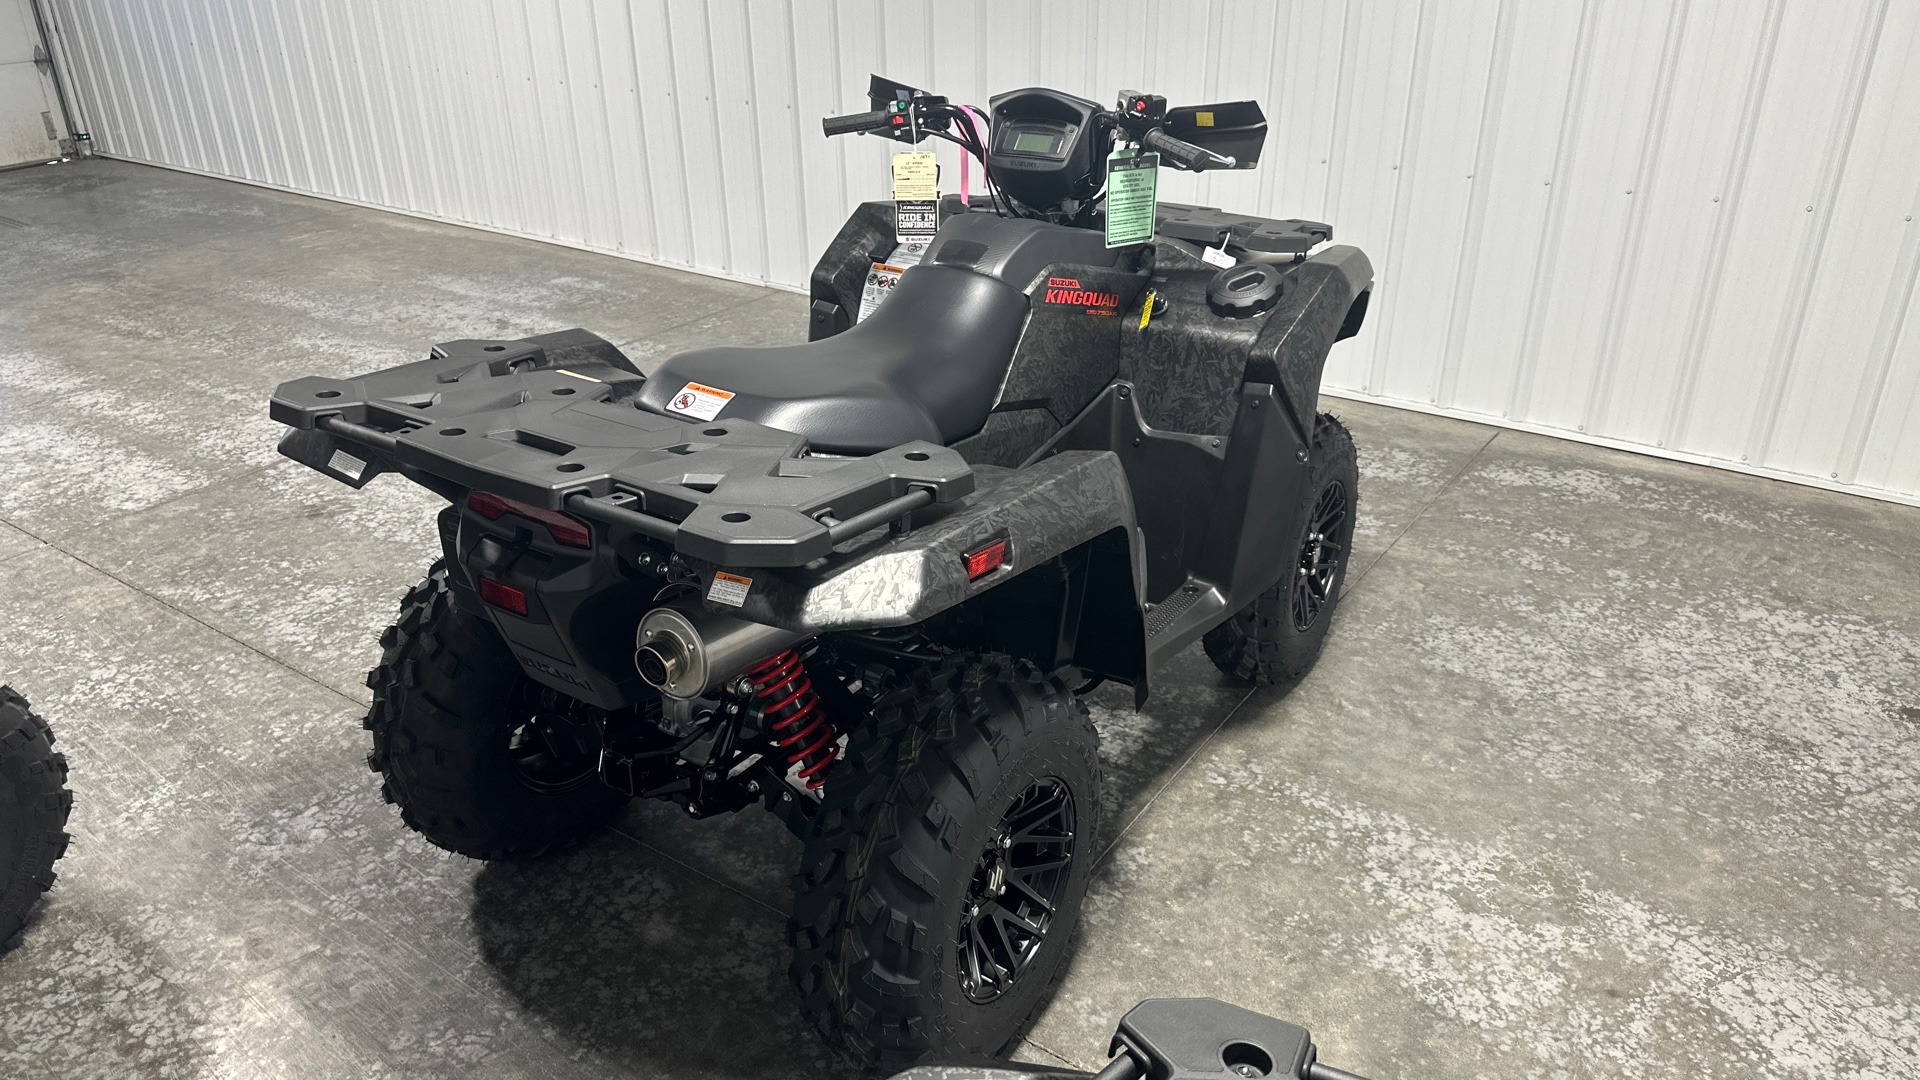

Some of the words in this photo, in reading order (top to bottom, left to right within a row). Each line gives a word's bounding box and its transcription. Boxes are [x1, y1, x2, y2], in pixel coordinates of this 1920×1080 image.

[898, 213, 922, 222] RIDE
[923, 213, 936, 222] IN
[898, 221, 936, 229] CONFIDENCE
[1050, 279, 1077, 287] SUZUKI
[1045, 289, 1120, 307] KINGQUAD
[515, 652, 595, 693] SUZUKI
